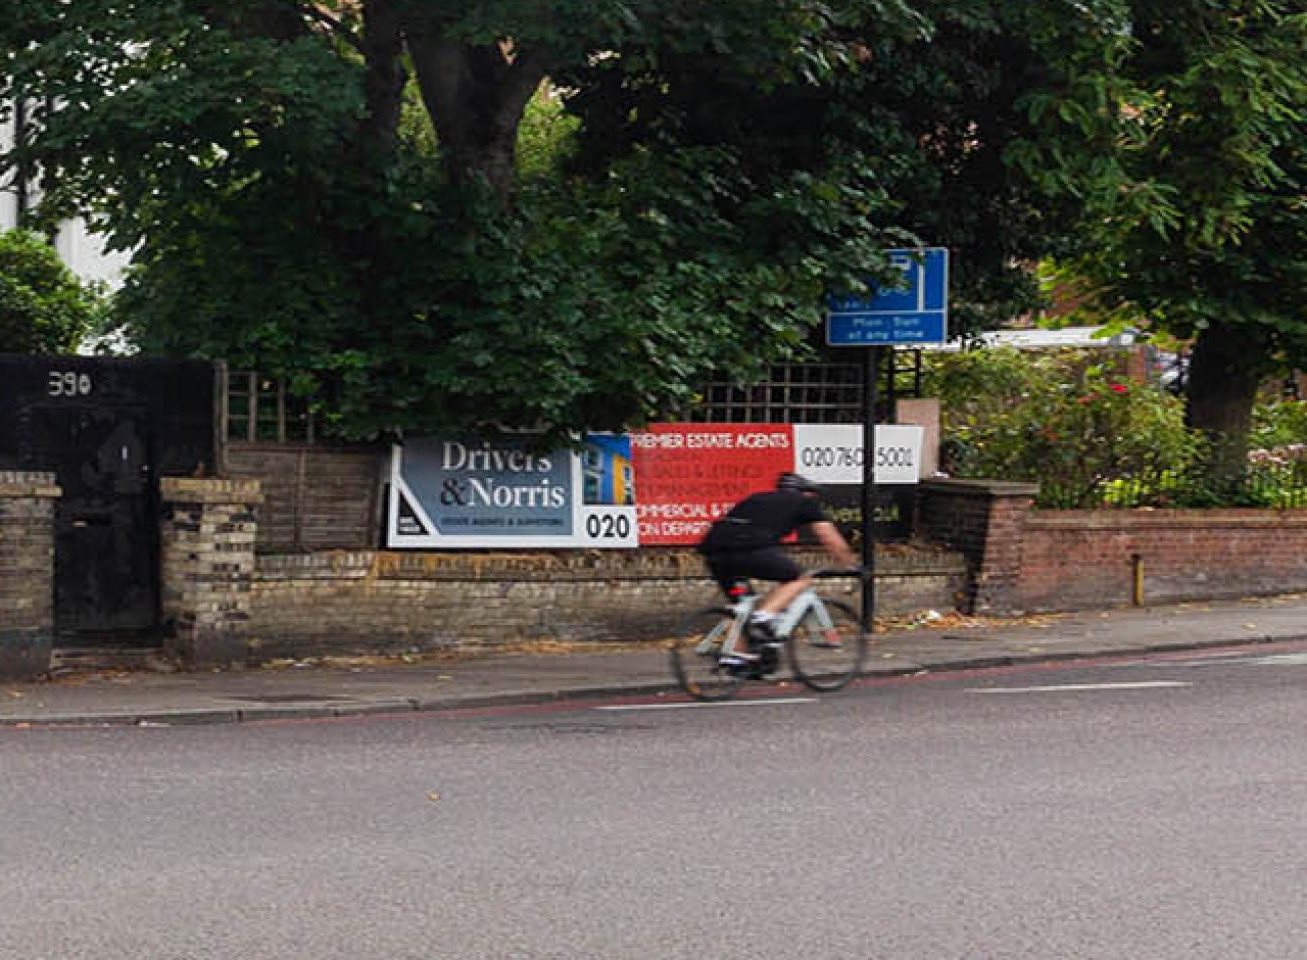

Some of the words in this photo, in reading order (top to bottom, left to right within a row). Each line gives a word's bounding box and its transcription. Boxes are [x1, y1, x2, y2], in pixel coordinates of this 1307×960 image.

[687, 432, 733, 448] ESTATE
[736, 432, 789, 448] AGENTS
[441, 441, 553, 473] Drivers
[585, 513, 630, 538] 020
